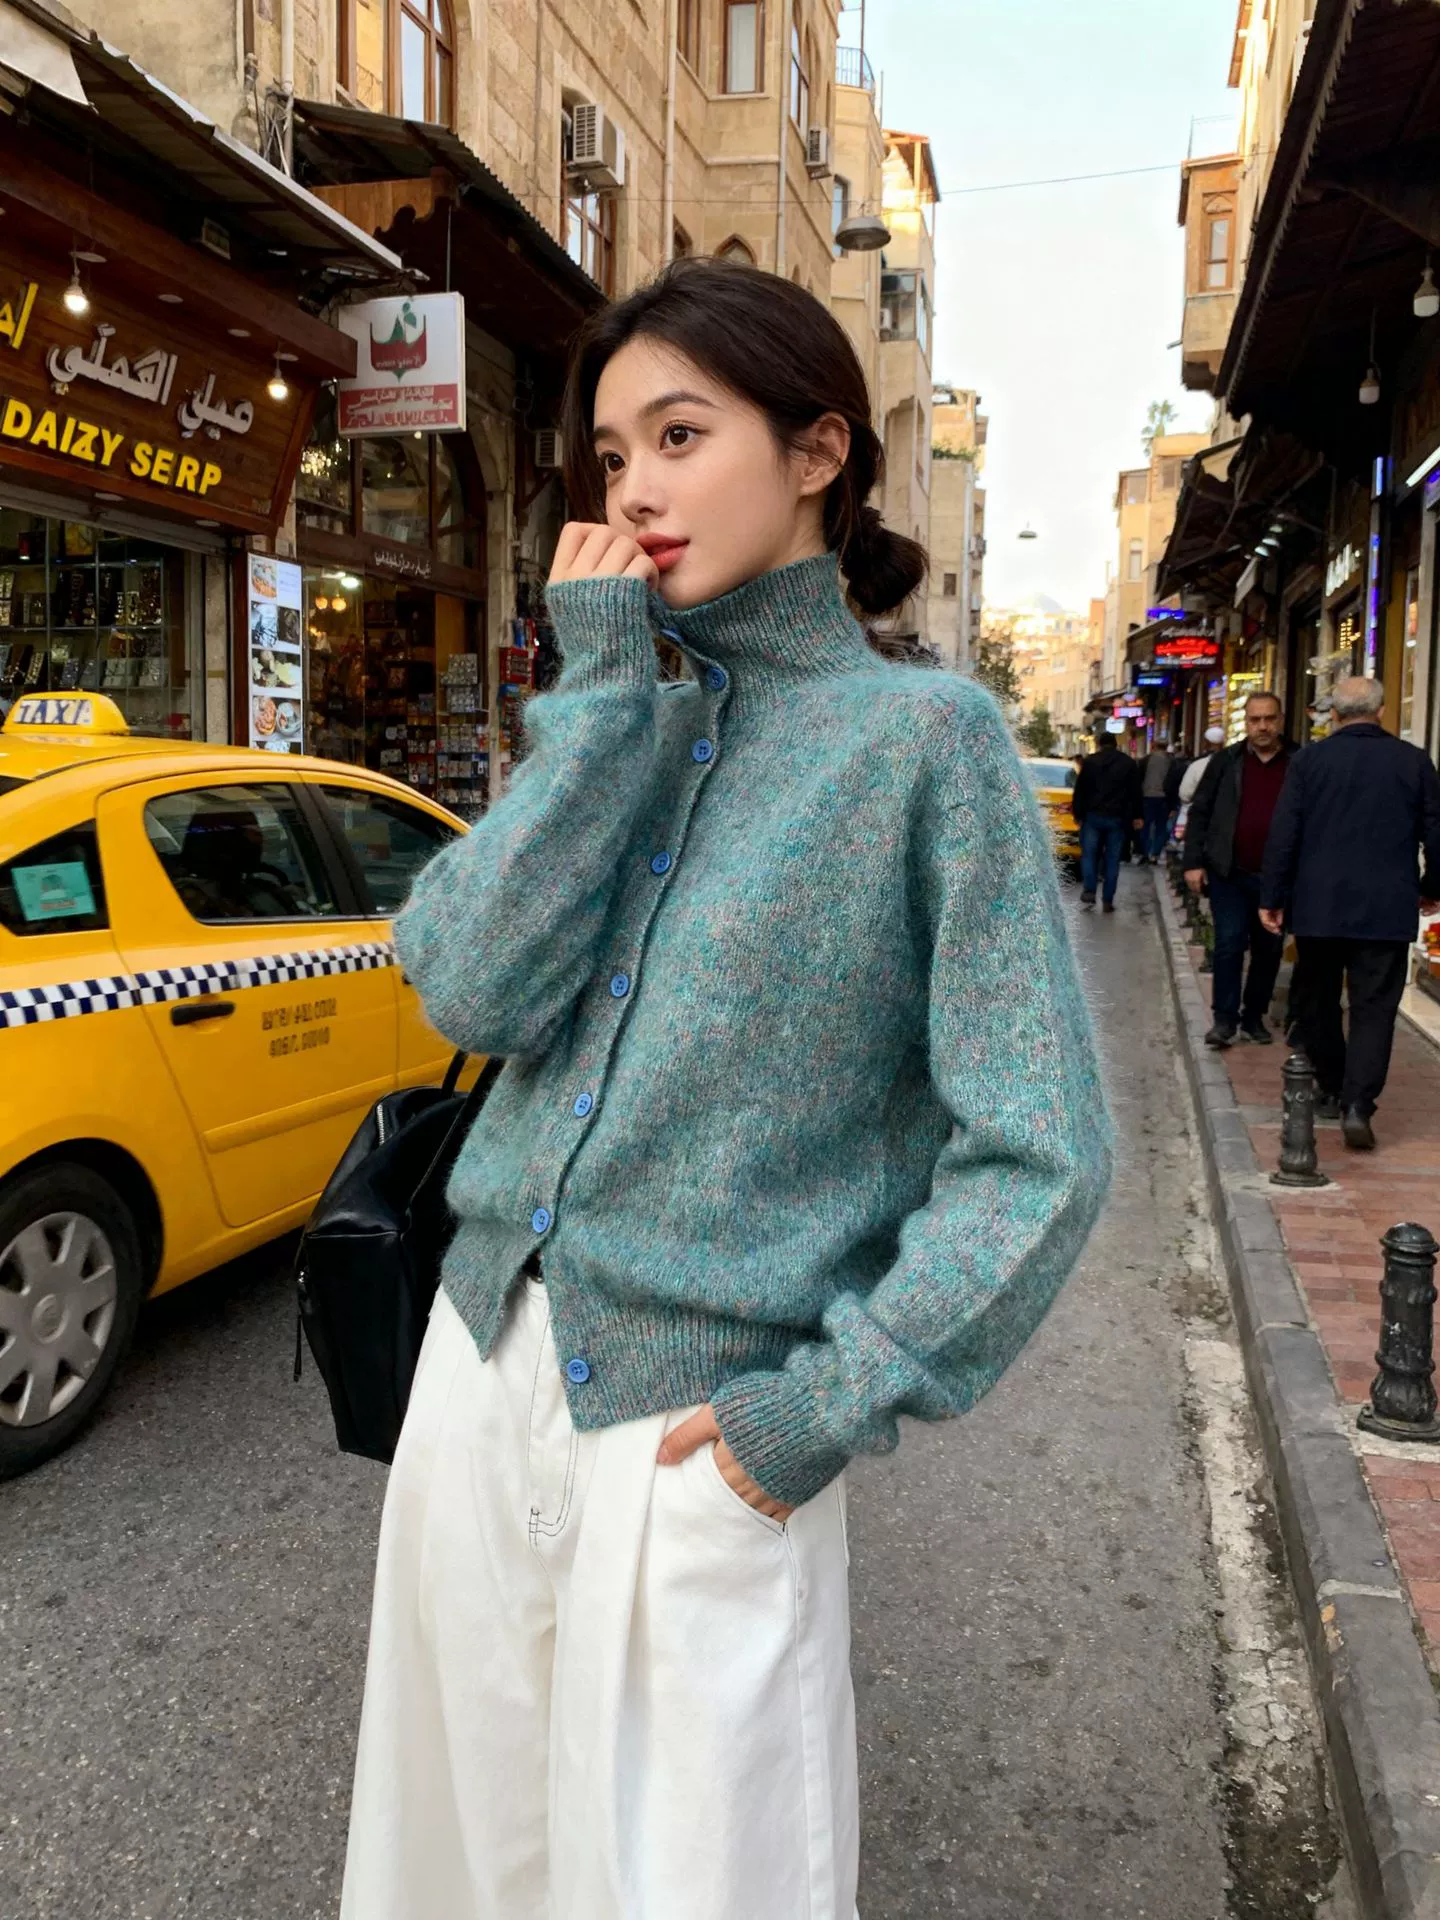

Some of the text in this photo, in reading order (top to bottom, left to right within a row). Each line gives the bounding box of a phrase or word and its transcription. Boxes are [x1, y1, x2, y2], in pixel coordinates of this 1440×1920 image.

[1, 398, 222, 495] DAIZY SERP
[17, 699, 85, 724] TAXI
